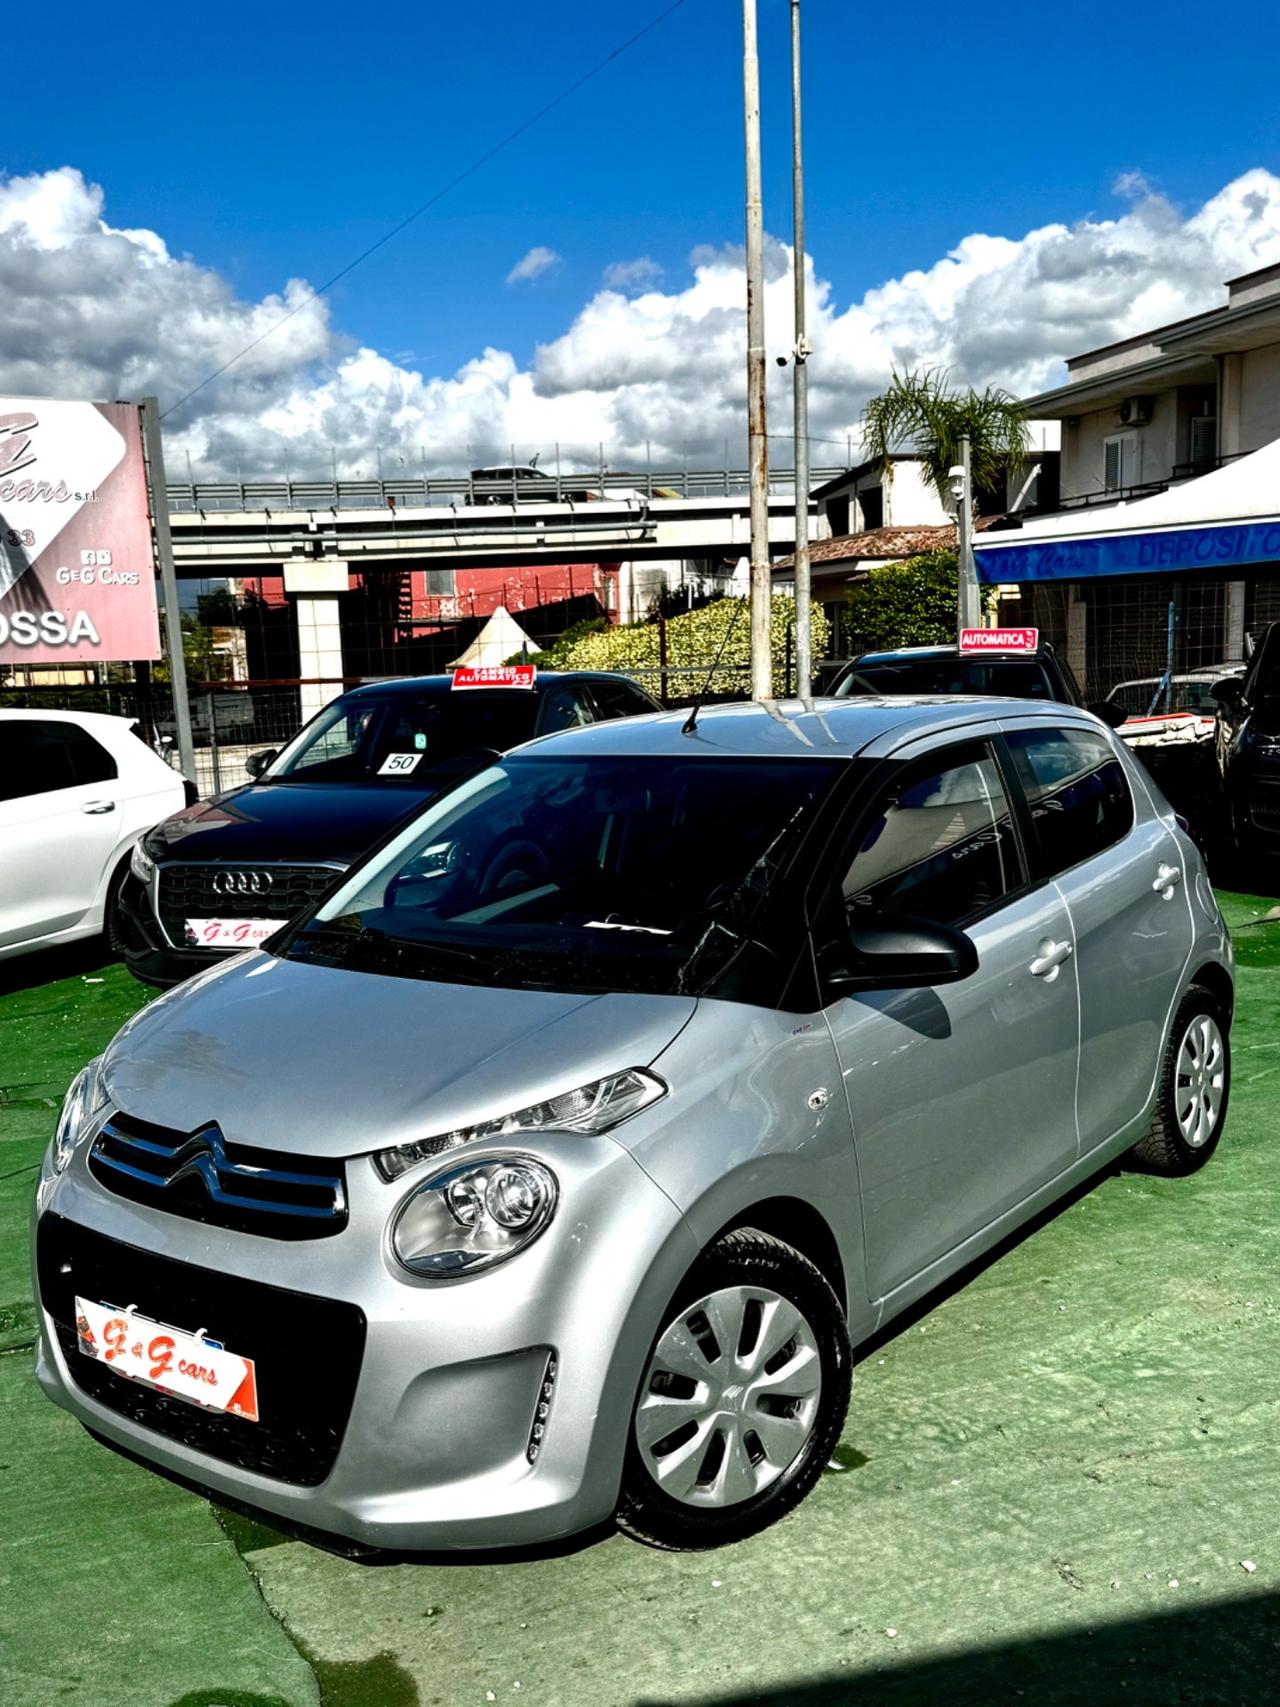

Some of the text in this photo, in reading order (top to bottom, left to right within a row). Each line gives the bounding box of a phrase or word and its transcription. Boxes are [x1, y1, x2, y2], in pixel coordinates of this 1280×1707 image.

[963, 633, 1024, 645] AUTOMATICA
[458, 673, 530, 682] AUTOMATICO
[473, 667, 517, 676] CAMBIO
[388, 755, 415, 770] 50
[103, 1318, 128, 1361] G
[147, 1335, 176, 1380] G
[178, 1357, 218, 1386] cars
